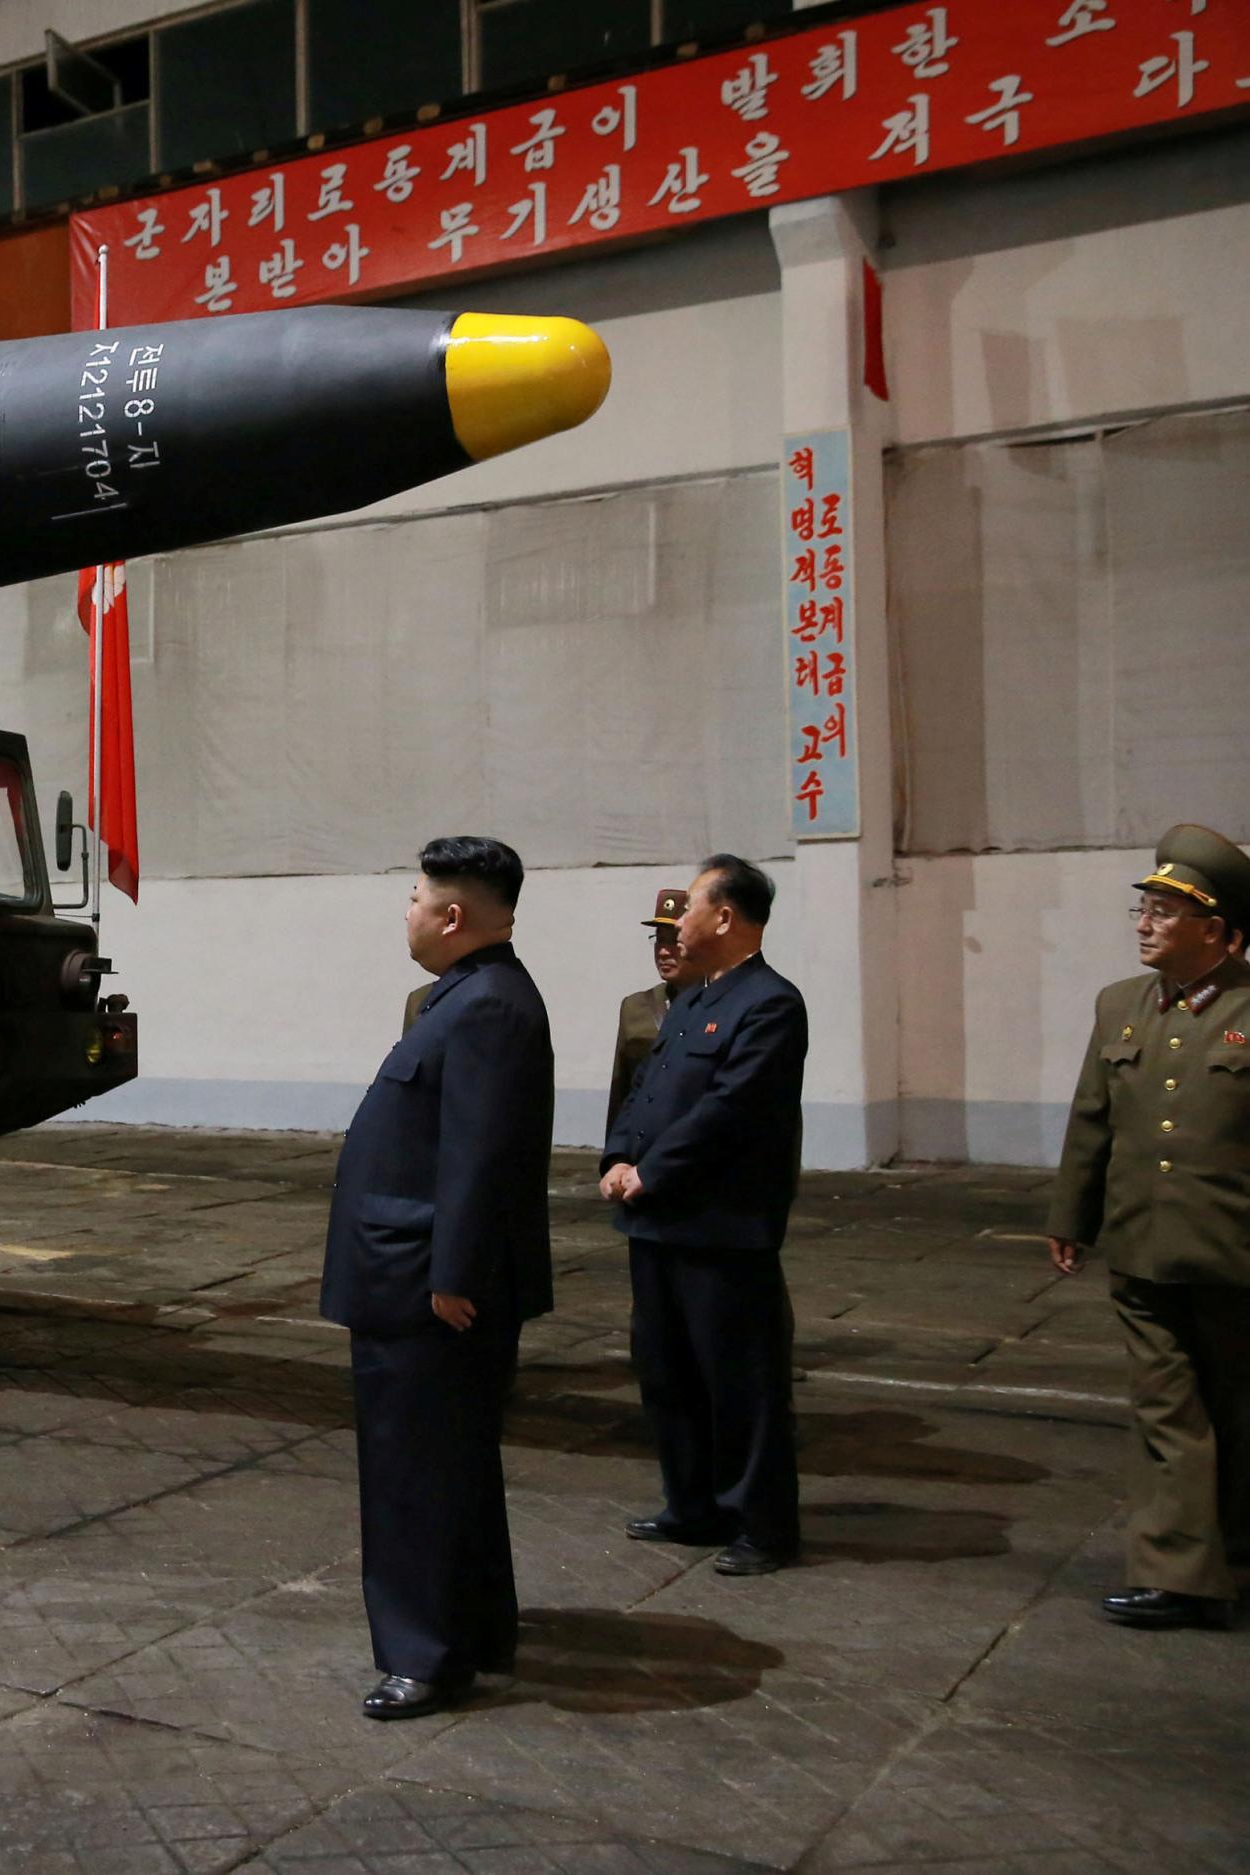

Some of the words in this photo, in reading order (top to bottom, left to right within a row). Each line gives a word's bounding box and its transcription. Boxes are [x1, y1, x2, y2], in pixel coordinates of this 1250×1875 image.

[721, 7, 958, 121] 발휘한
[194, 223, 371, 311] 본받아
[427, 131, 791, 263] 무기생산을
[868, 75, 1034, 166] 적극
[816, 493, 847, 758] 로동계급의
